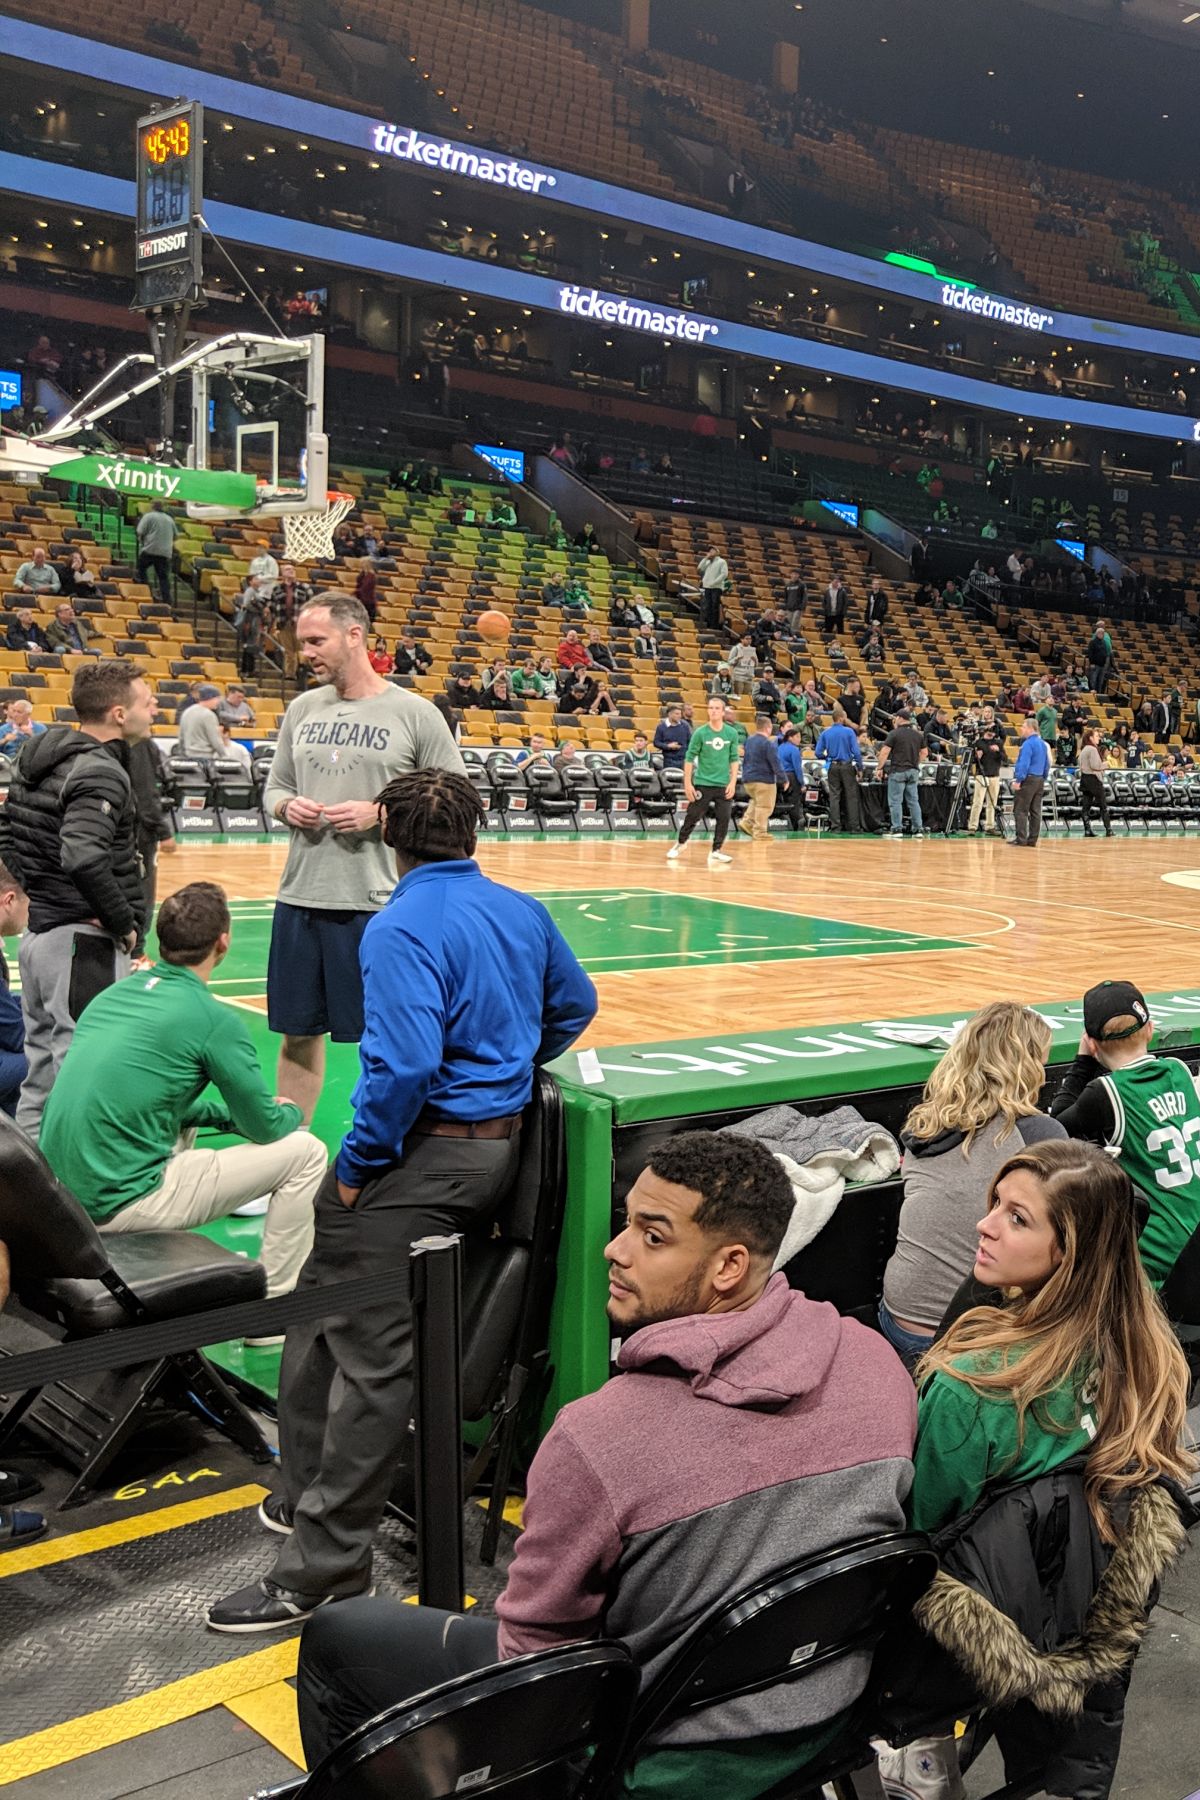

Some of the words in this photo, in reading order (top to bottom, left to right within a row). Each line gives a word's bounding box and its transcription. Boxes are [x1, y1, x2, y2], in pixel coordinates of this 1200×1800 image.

[146, 120, 190, 163] 45:43
[373, 124, 547, 193] ticketmaster
[151, 232, 188, 255] TISSOT
[559, 285, 710, 342] ticketmaster
[941, 284, 1047, 331] ticketmaster
[97, 463, 180, 498] xfinity
[296, 722, 391, 751] PELICANS
[1147, 1091, 1187, 1122] BIRD
[113, 1468, 222, 1500] 6AA
